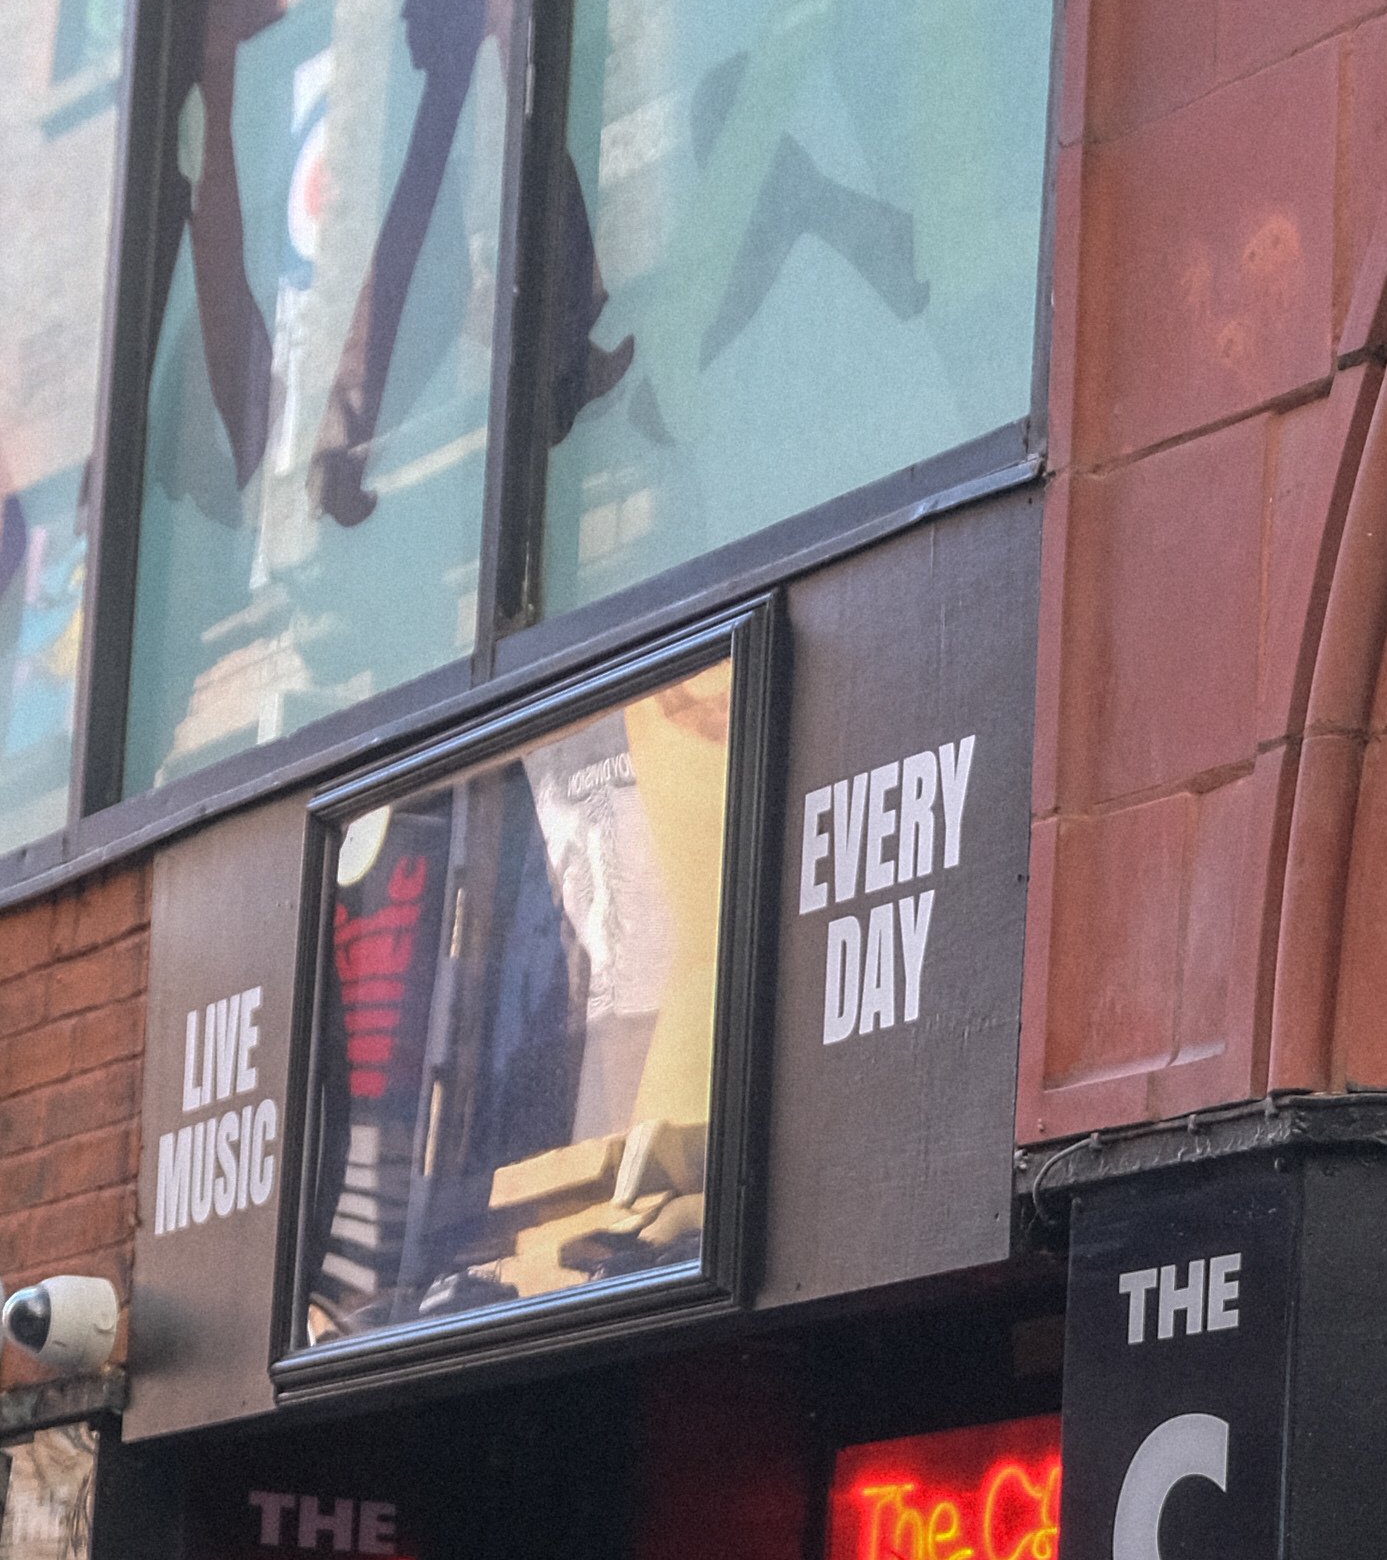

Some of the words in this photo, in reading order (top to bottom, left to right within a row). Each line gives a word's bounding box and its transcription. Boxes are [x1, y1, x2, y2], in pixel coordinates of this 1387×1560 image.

[799, 734, 976, 915] EVERY
[823, 890, 934, 1046] DAY
[181, 986, 263, 1113] LIVE
[155, 1099, 278, 1237] MUSIC
[1118, 1252, 1242, 1345] THE
[248, 1490, 397, 1555] THE
